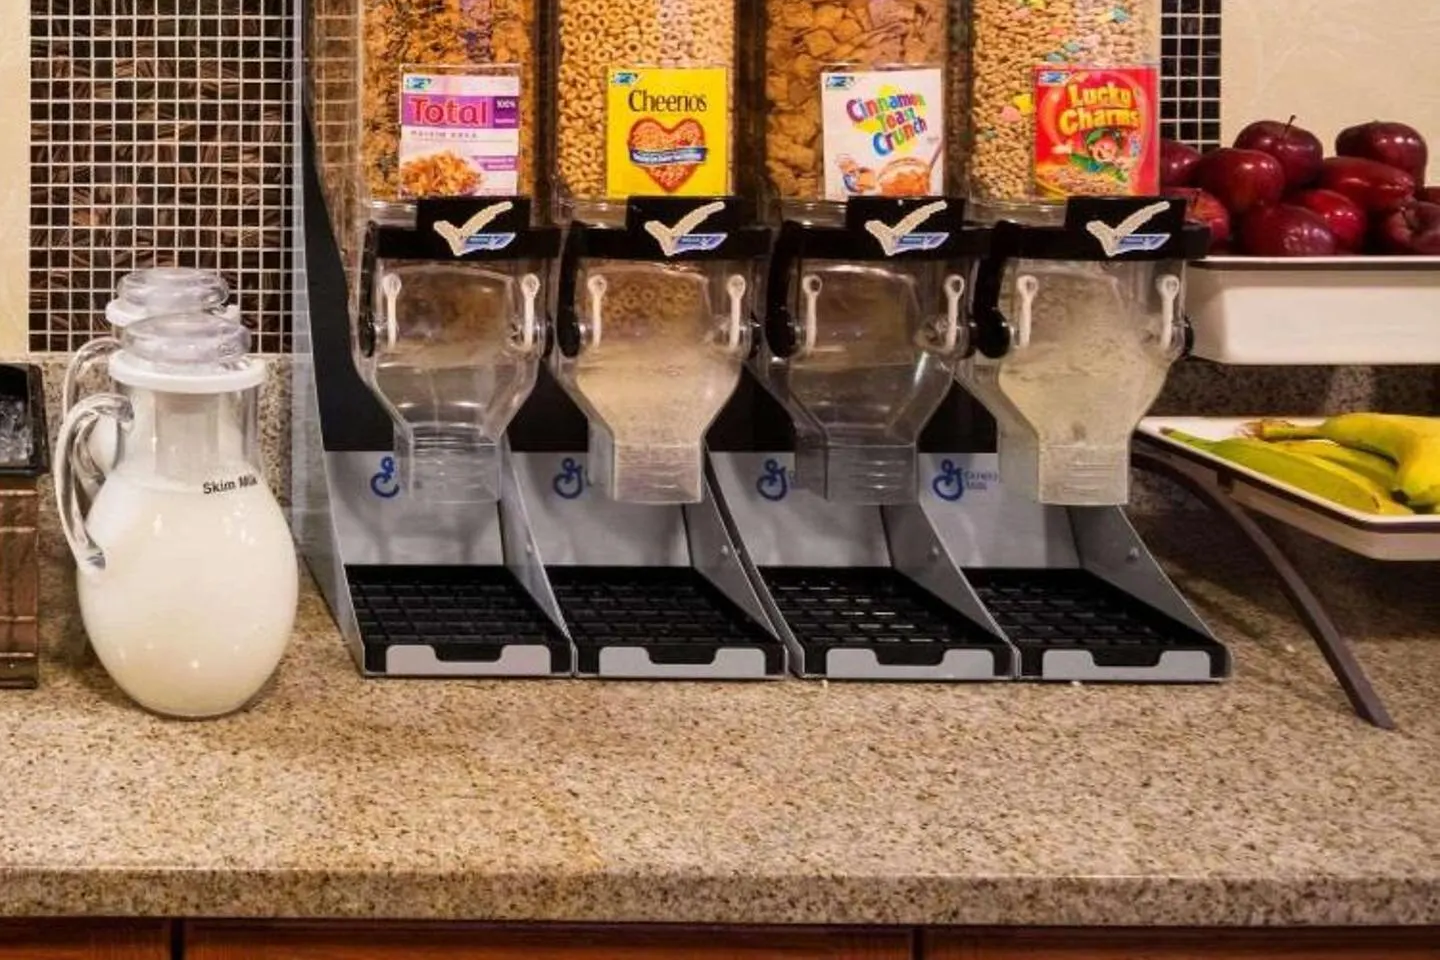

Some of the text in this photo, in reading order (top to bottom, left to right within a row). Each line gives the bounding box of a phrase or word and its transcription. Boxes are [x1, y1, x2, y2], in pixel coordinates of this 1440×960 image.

[628, 89, 708, 113] Cheerios
[846, 93, 927, 123] Cinnamon
[1066, 82, 1133, 109] Lucky
[410, 96, 488, 125] Total
[876, 107, 915, 132] Toast
[1059, 108, 1141, 137] Charms
[872, 116, 928, 156] Crunch
[202, 480, 236, 495] Skim
